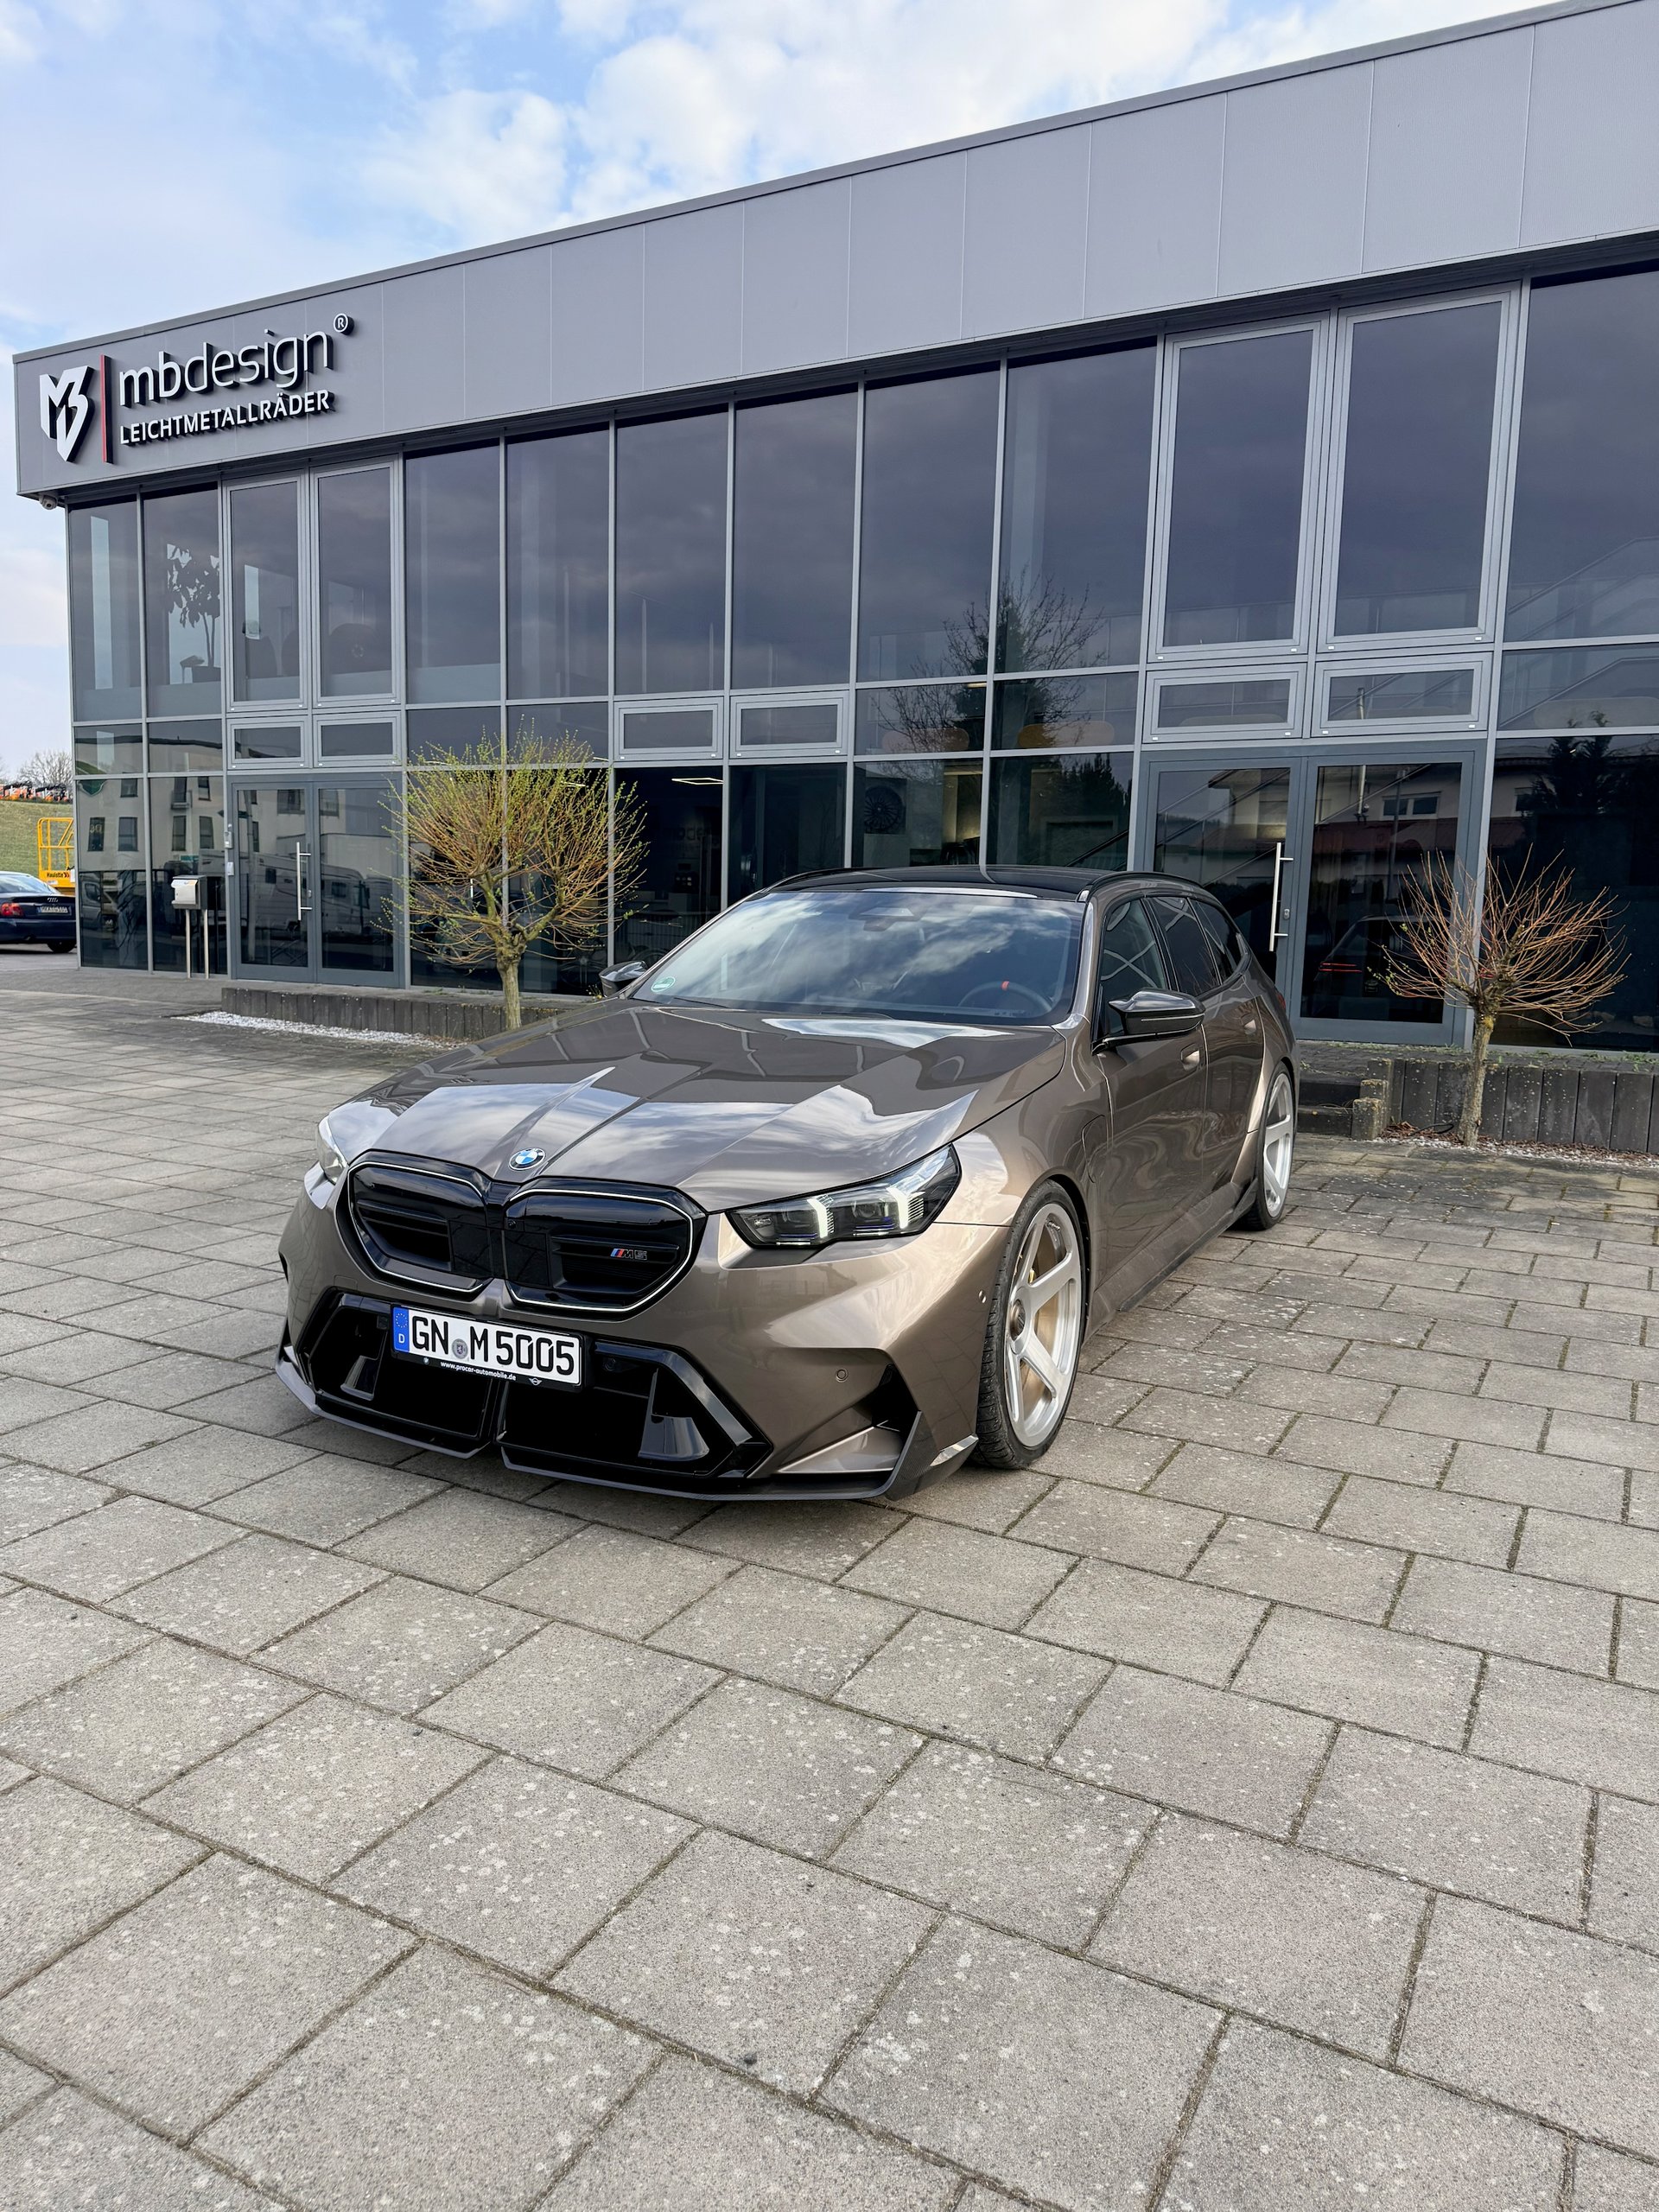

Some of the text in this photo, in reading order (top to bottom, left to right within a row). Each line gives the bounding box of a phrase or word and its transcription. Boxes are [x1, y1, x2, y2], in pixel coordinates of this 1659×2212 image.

[120, 390, 330, 444] LEICHTMETALLRÄDER
[398, 1333, 405, 1344] D
[411, 1315, 449, 1355] GN
[495, 1330, 575, 1376] 5005
[440, 1361, 517, 1381] www.procar-automobile.de
